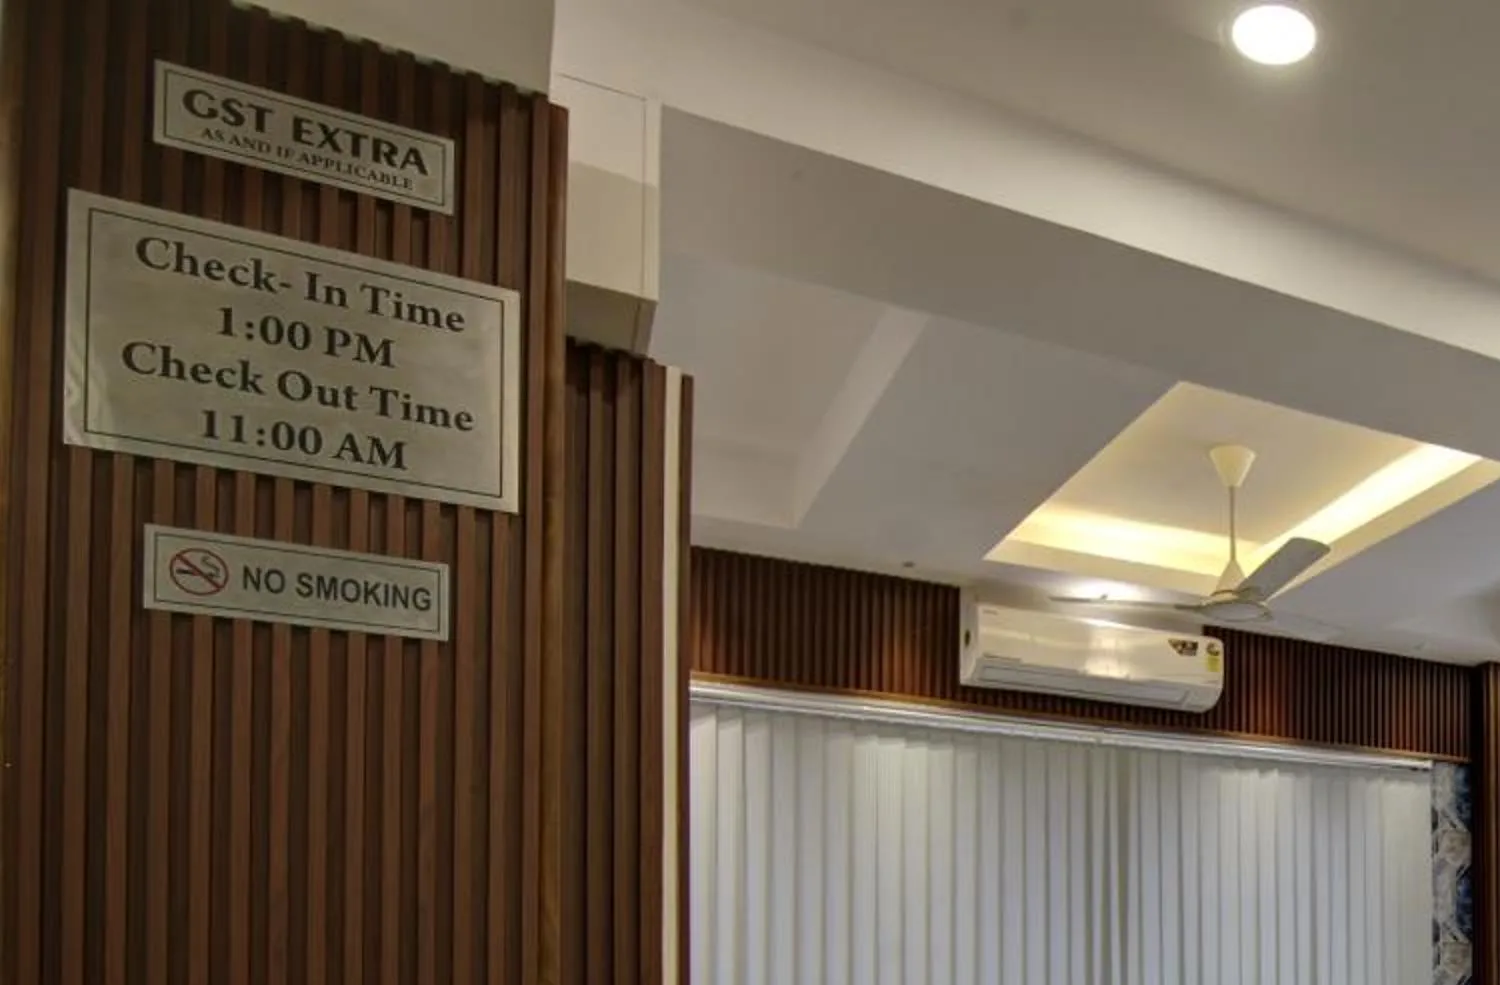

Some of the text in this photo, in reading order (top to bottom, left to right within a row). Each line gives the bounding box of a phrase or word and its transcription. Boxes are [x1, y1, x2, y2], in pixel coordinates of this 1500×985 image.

[183, 89, 428, 176] GST EXTRA
[202, 127, 413, 190] AS AND IF APPLICABLE
[303, 271, 349, 309] In
[360, 283, 466, 333] Time
[216, 306, 396, 368] 1:00 PM
[122, 341, 474, 432] Check Out Time
[202, 409, 409, 471] 11:00 AM
[243, 565, 432, 611] NO SMOKING
